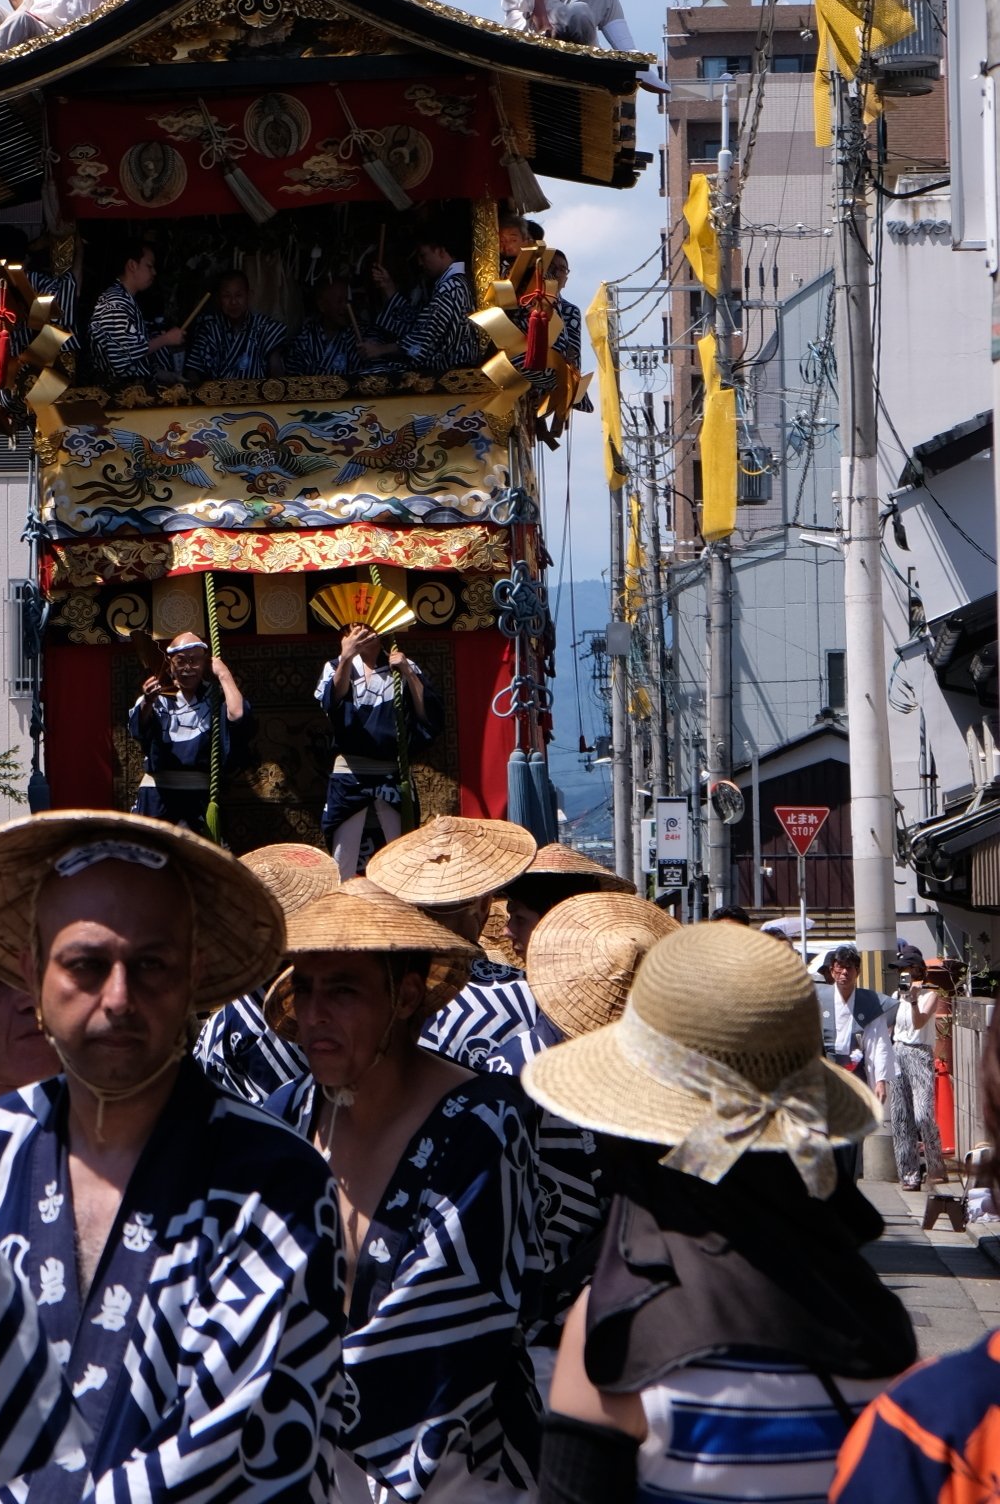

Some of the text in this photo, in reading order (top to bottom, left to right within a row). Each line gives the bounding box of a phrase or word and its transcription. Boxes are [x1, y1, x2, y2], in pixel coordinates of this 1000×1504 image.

[786, 813, 818, 824] 止まれ
[792, 826, 814, 836] STOP
[663, 866, 683, 886] 空
